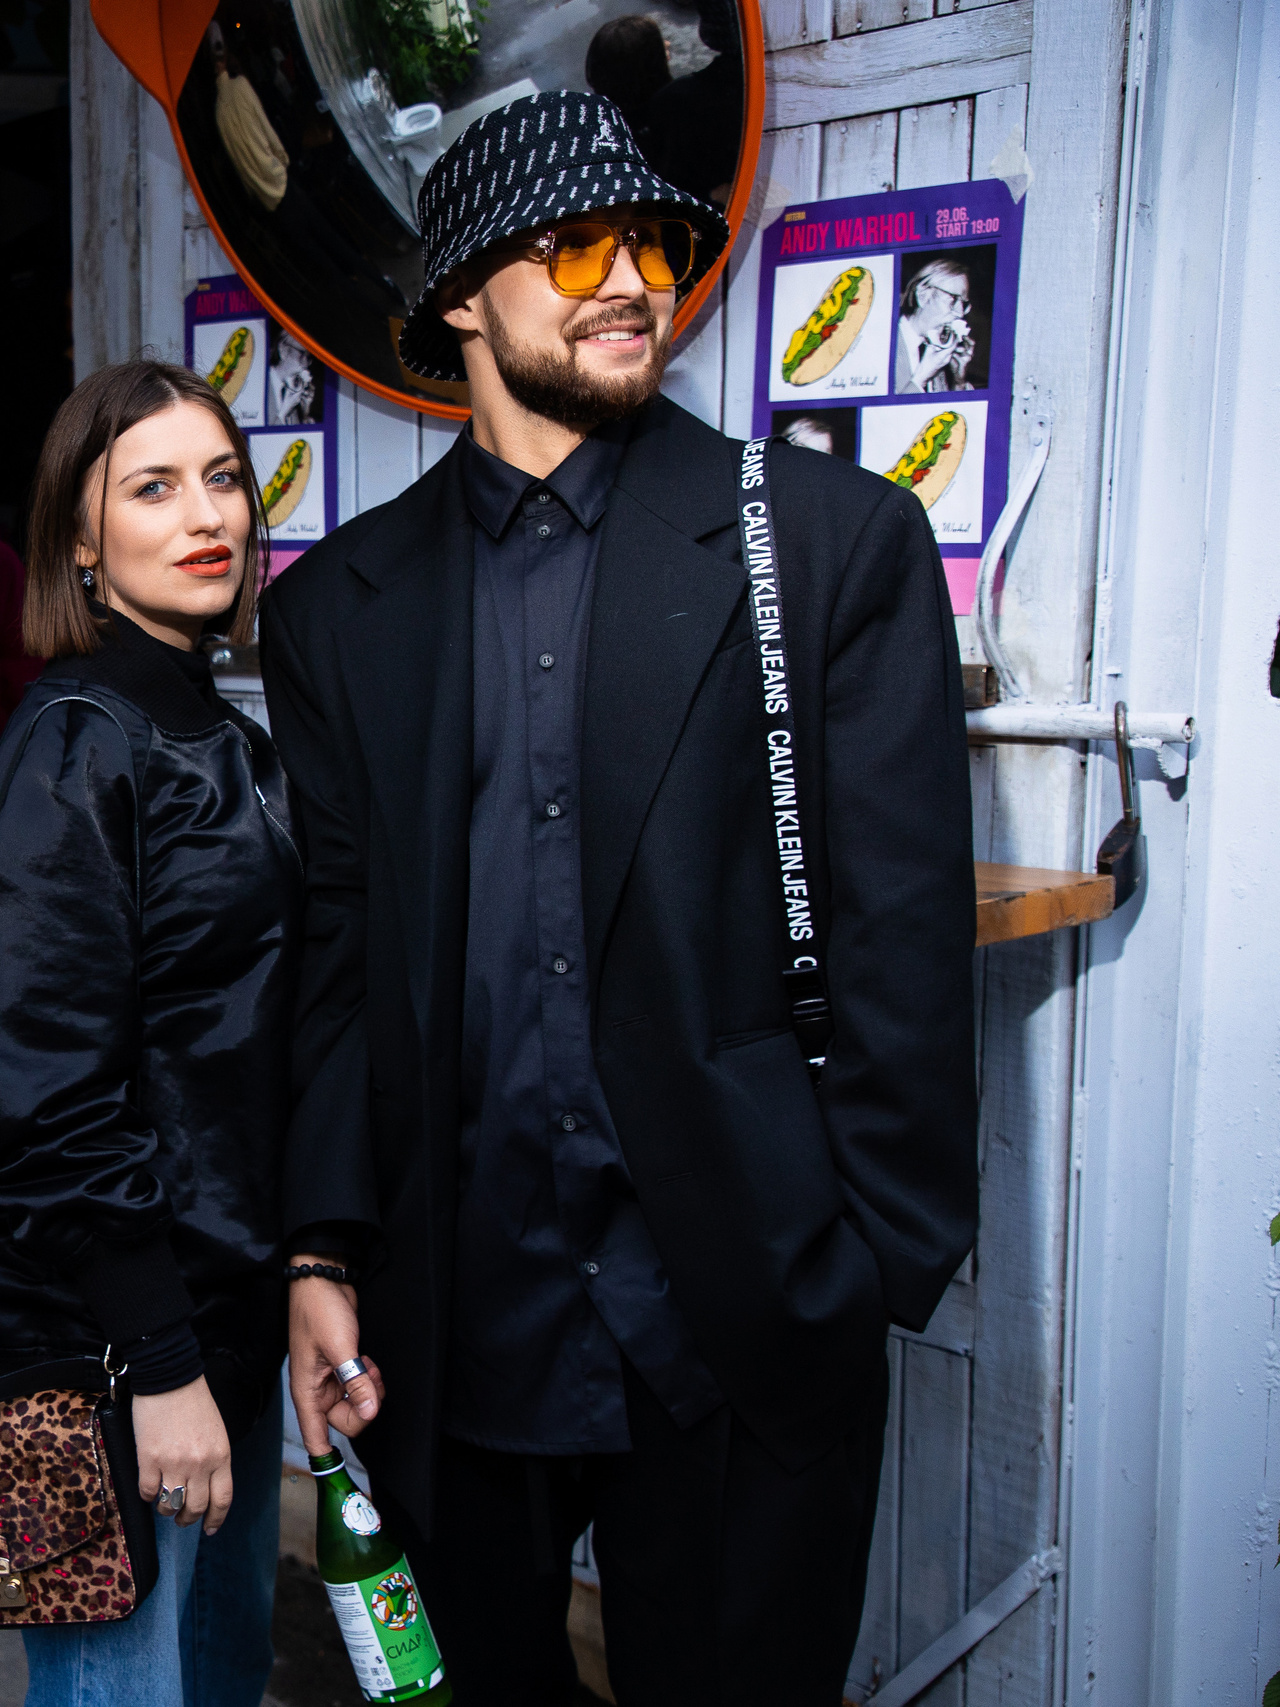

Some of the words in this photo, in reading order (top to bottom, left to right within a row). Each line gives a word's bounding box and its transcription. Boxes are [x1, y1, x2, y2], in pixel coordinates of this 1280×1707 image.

[935, 207, 970, 224] 29.06.
[935, 221, 969, 239] START
[970, 217, 1000, 235] 19:00
[780, 221, 830, 255] ANDY
[834, 211, 921, 249] WARHOL
[195, 291, 226, 316] ANDY
[760, 643, 789, 714] JEANS
[782, 873, 814, 941] JEANS
